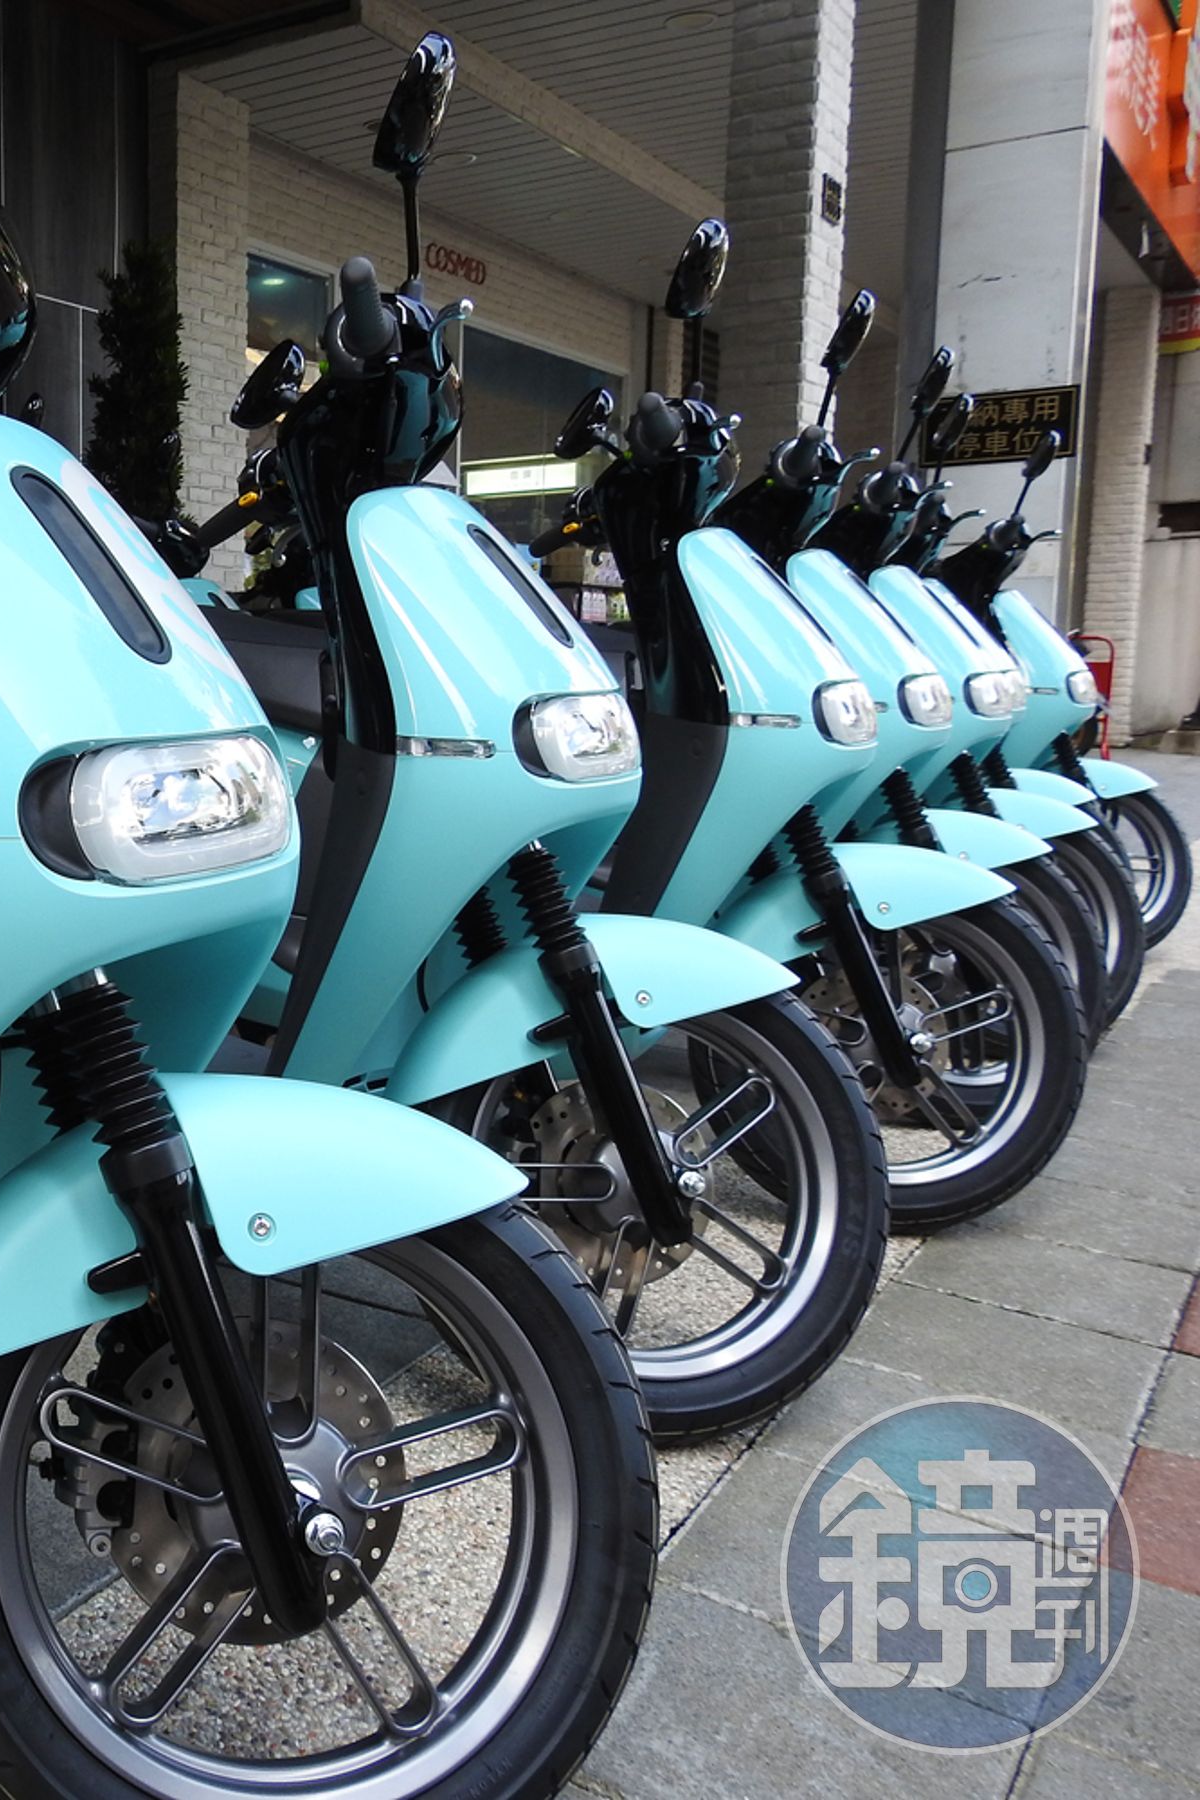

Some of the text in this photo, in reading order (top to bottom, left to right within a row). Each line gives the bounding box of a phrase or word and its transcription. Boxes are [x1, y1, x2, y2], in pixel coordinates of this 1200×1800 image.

[425, 242, 487, 286] COSMED
[940, 394, 1061, 428] 納專用
[953, 427, 1043, 460] 停車位
